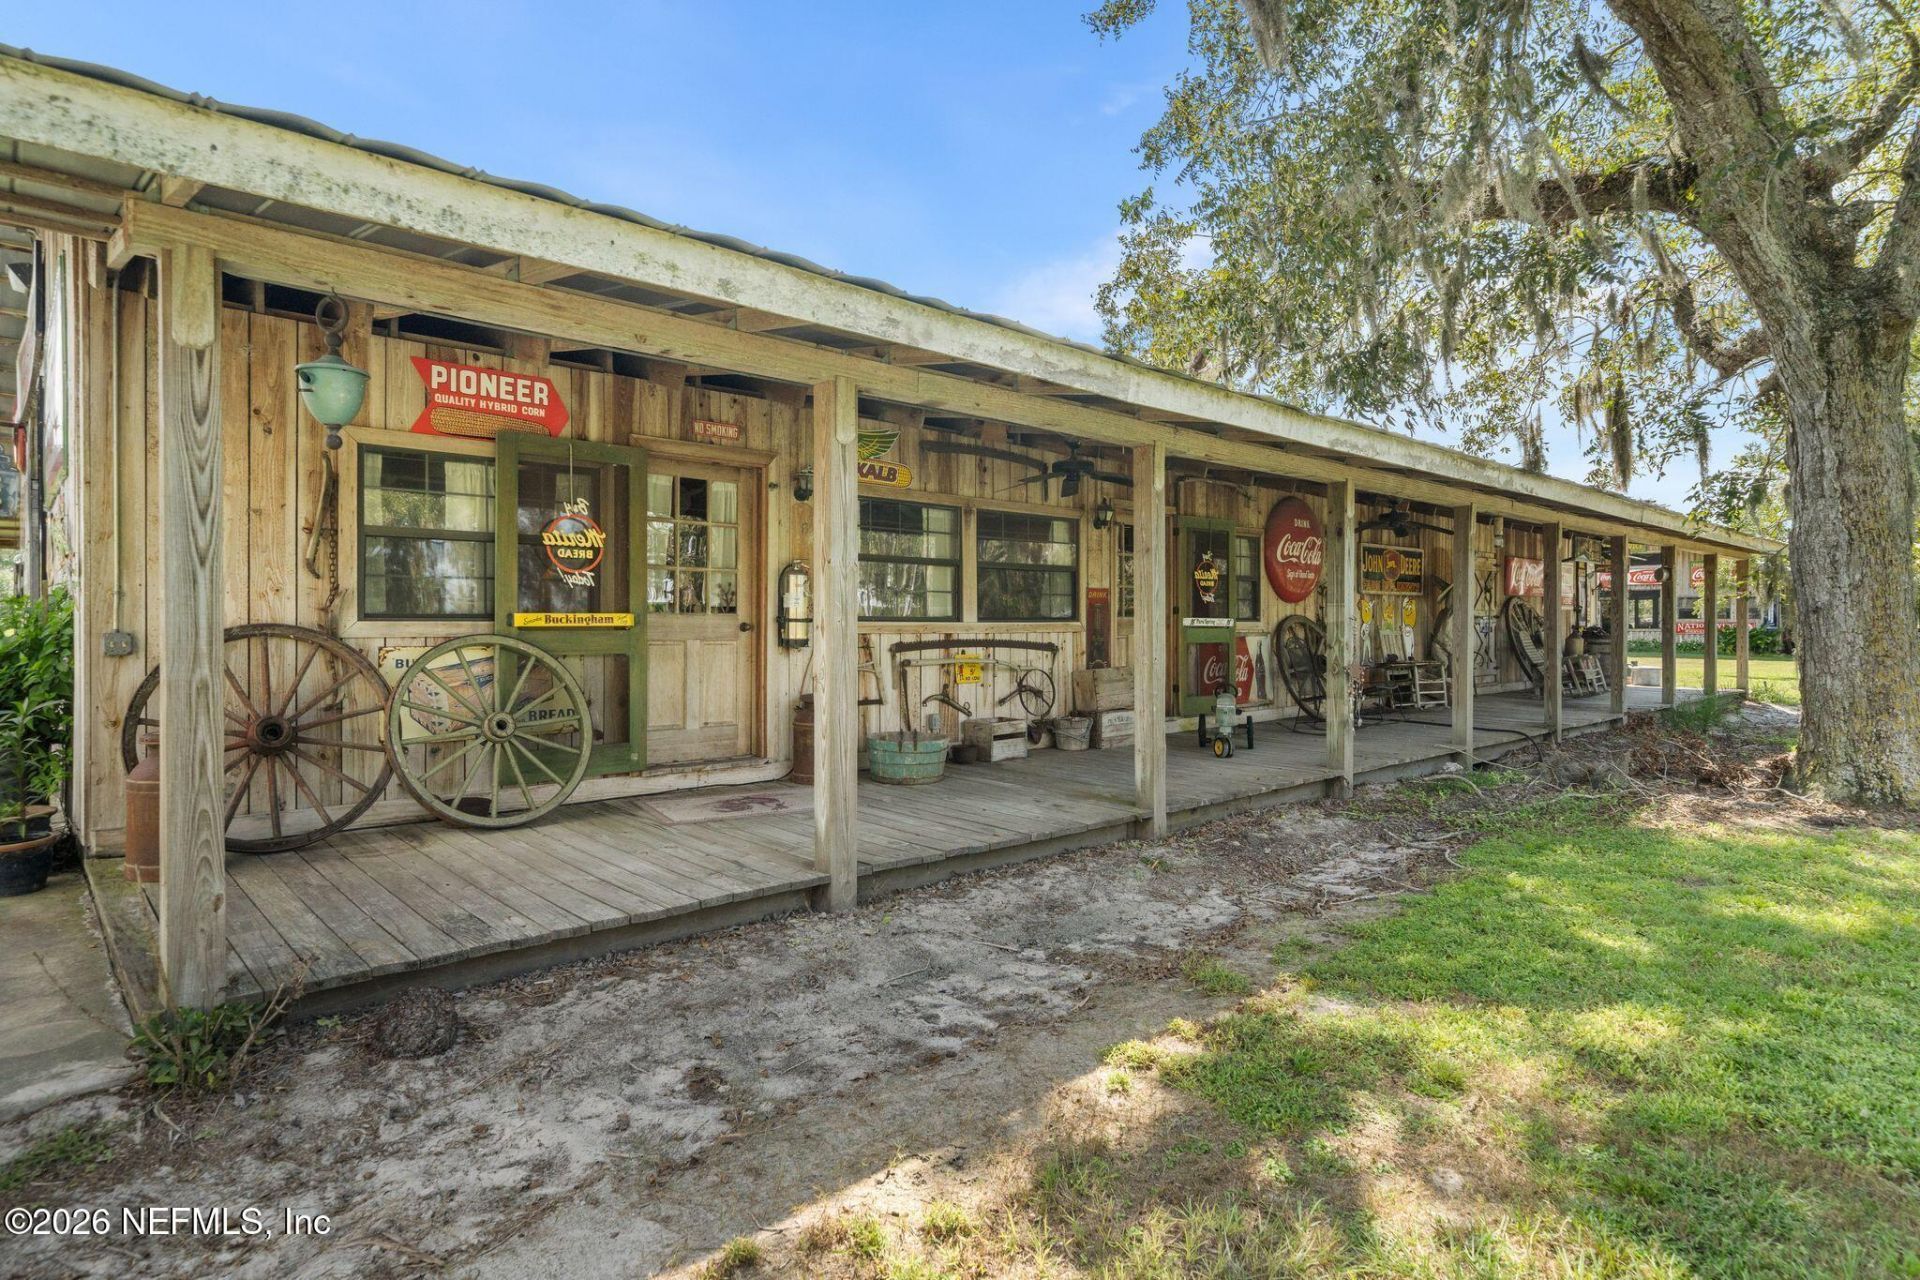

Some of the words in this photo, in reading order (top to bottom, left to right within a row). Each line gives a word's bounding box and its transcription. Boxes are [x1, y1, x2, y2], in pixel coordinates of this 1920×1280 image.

[431, 364, 549, 406] PIONEER
[434, 393, 476, 408] QUALITY
[479, 399, 518, 413] HYBRID
[521, 405, 546, 418] CORN
[694, 421, 705, 434] NO
[705, 423, 738, 438] SMOKING
[1276, 533, 1322, 565] Coca-Cola
[1362, 551, 1383, 573] JOHN
[1400, 554, 1421, 576] DEERE
[544, 614, 614, 625] Buckingham
[528, 708, 576, 721] BREAD
